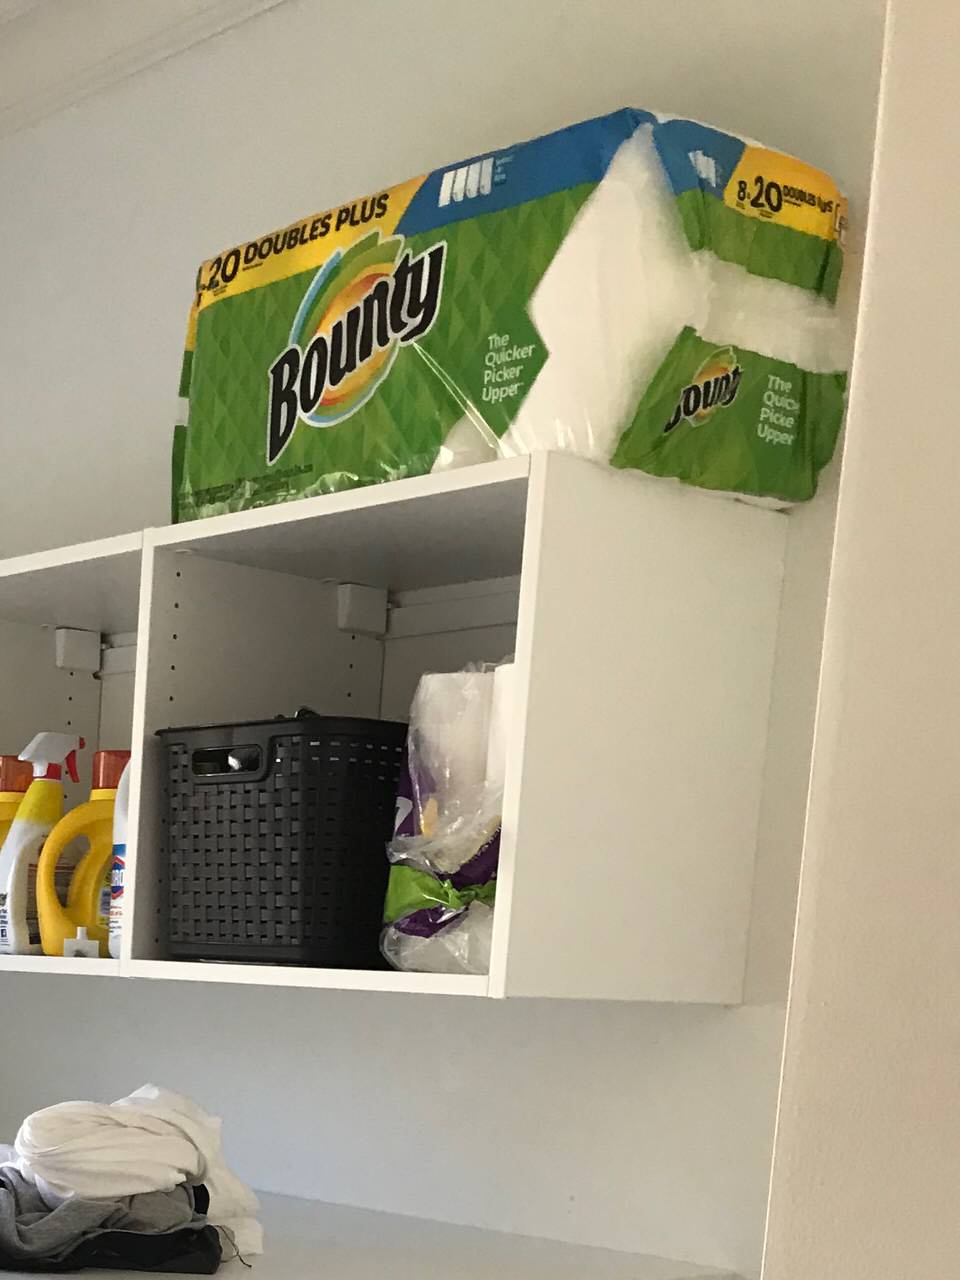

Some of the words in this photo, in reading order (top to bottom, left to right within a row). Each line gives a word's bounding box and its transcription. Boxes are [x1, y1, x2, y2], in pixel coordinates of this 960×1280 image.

[243, 211, 332, 265] DOUBLES
[334, 192, 391, 233] PLUS
[488, 333, 510, 350] The
[269, 245, 445, 462] Bounty
[484, 343, 536, 368] Quicker
[483, 363, 524, 386] Picker
[768, 375, 792, 392] The
[481, 382, 521, 403] Upper
[757, 423, 795, 446] Upper
